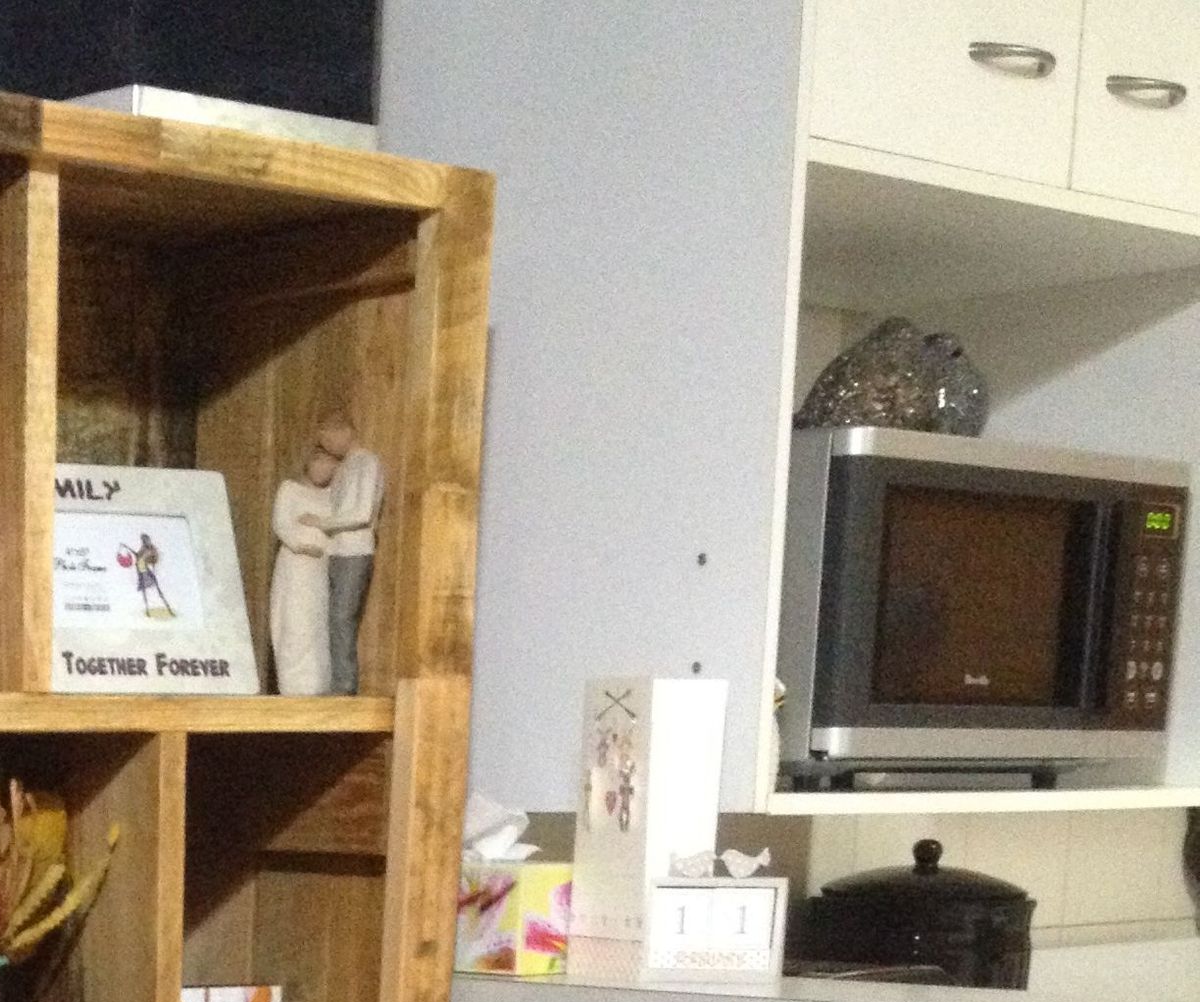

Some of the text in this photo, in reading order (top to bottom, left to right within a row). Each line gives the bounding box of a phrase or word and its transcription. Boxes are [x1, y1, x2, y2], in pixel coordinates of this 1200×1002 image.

[62, 650, 230, 677] TOGETHER FOREVER
[675, 905, 686, 935] 1
[736, 905, 747, 935] 1
